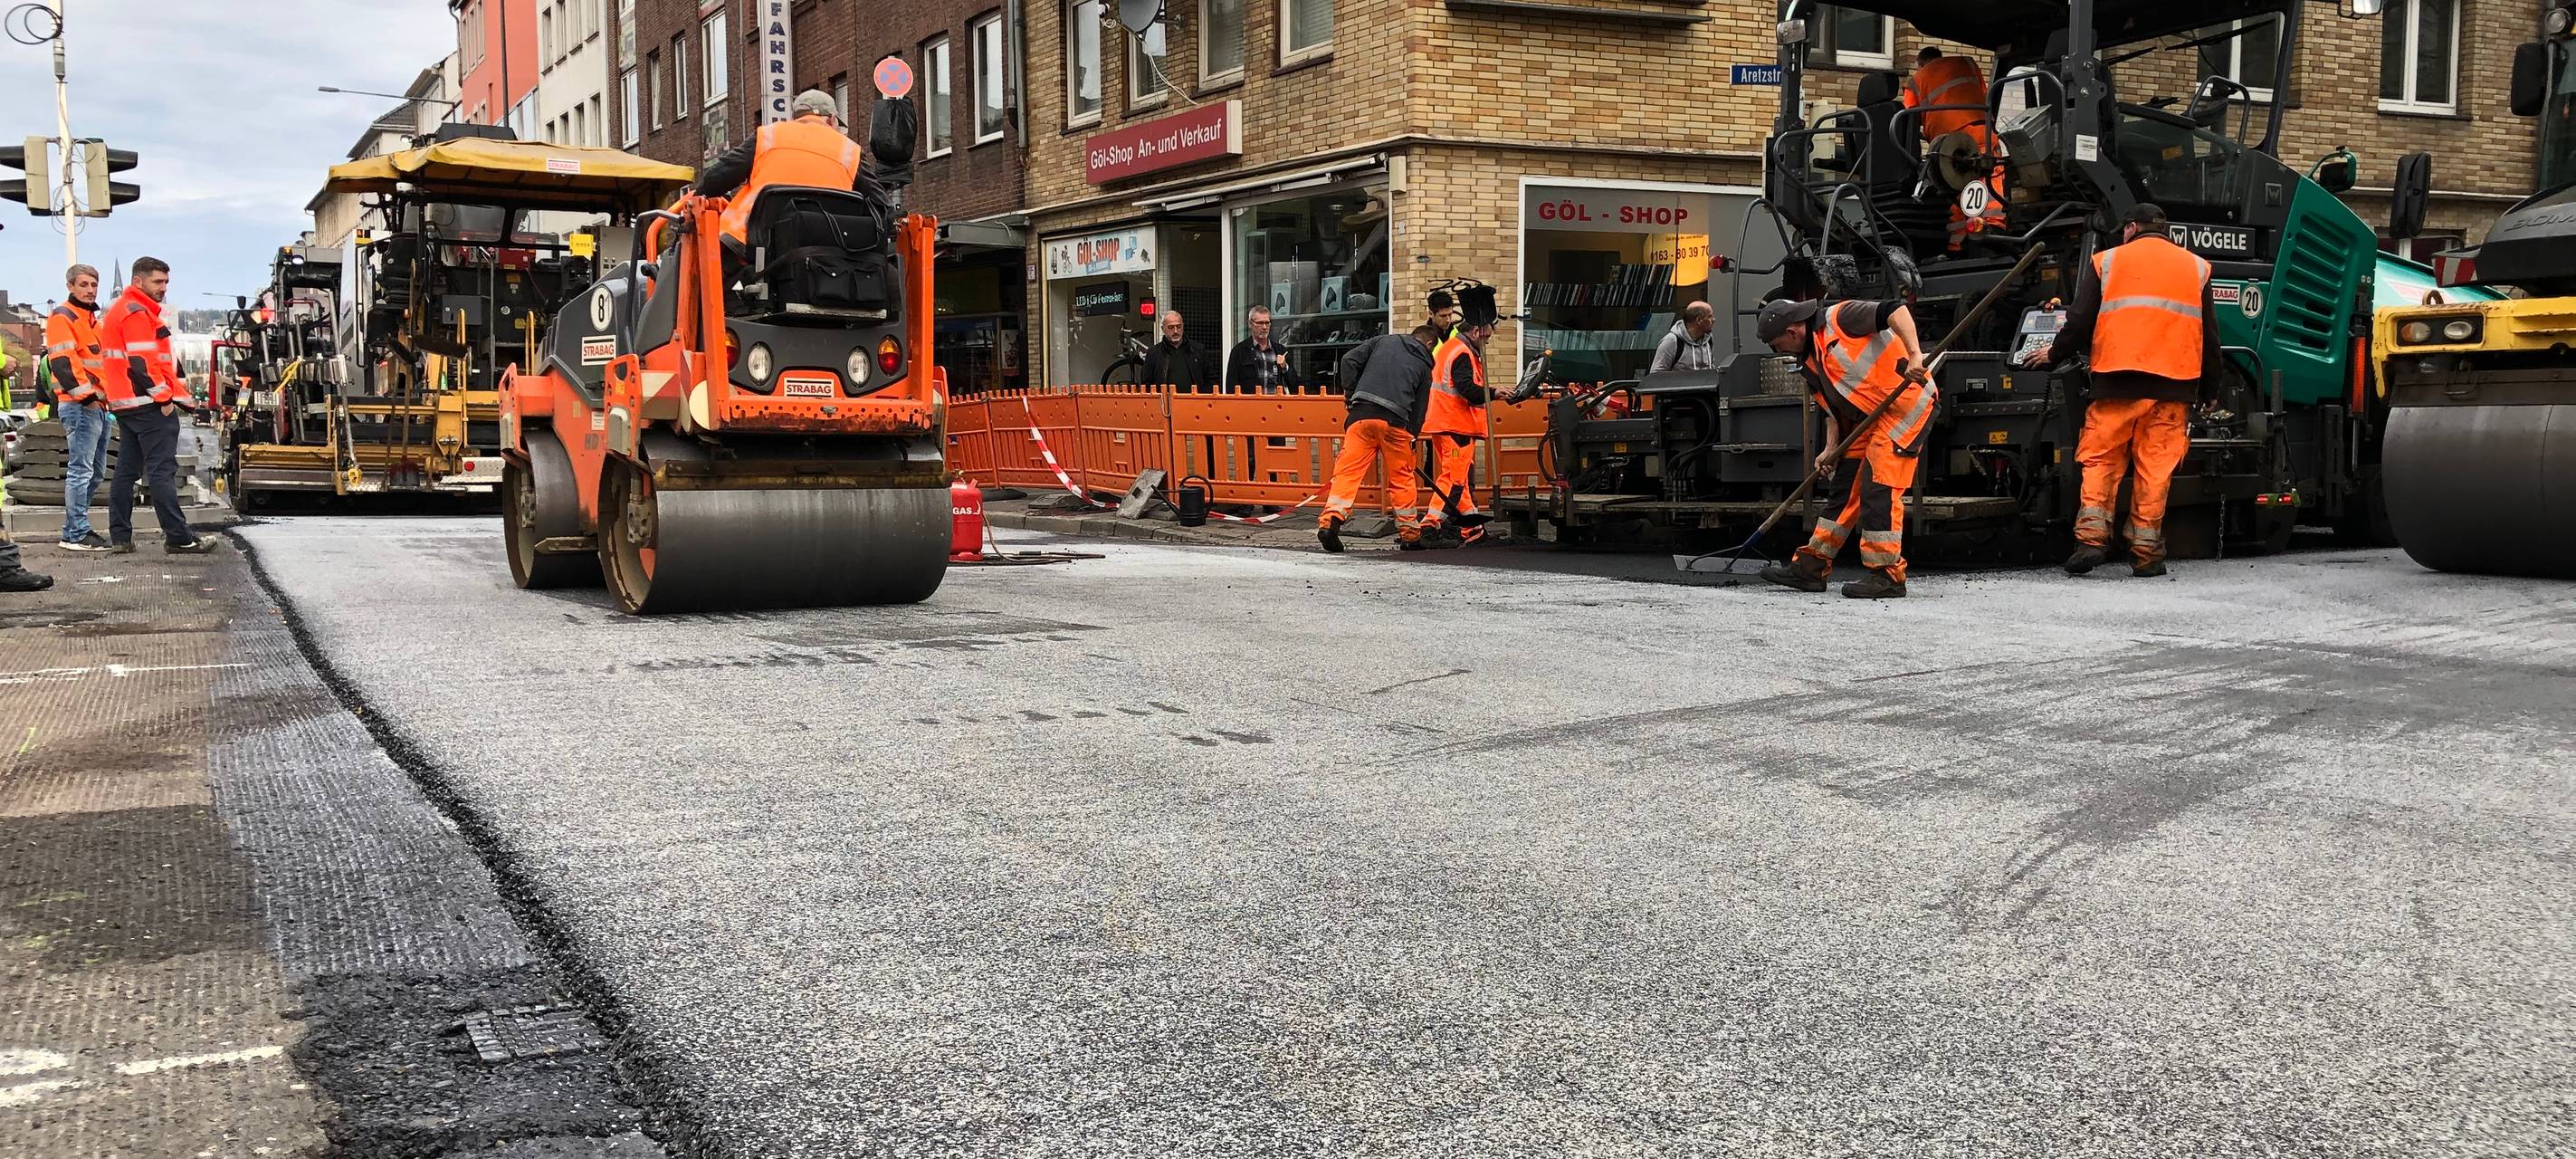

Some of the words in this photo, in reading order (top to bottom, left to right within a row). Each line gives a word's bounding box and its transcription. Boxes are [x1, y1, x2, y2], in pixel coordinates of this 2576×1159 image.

[768, 2, 787, 121] FAHRSC
[1741, 67, 1781, 82] Aretzstr
[1091, 144, 1133, 170] Göl-Shop
[1138, 139, 1156, 158] An-
[1158, 130, 1178, 153] und
[1179, 118, 1222, 148] Verkauf
[1966, 187, 1983, 209] 20
[1539, 199, 1592, 222] GÖL
[1619, 206, 1688, 225] SHOP
[2191, 226, 2247, 250] VÖGELE
[1077, 236, 1120, 265] GÖL-SHOP
[2245, 291, 2259, 311] 20
[583, 344, 615, 357] STRABAG
[787, 384, 832, 394] STRABAG
[952, 506, 972, 515] GAS
